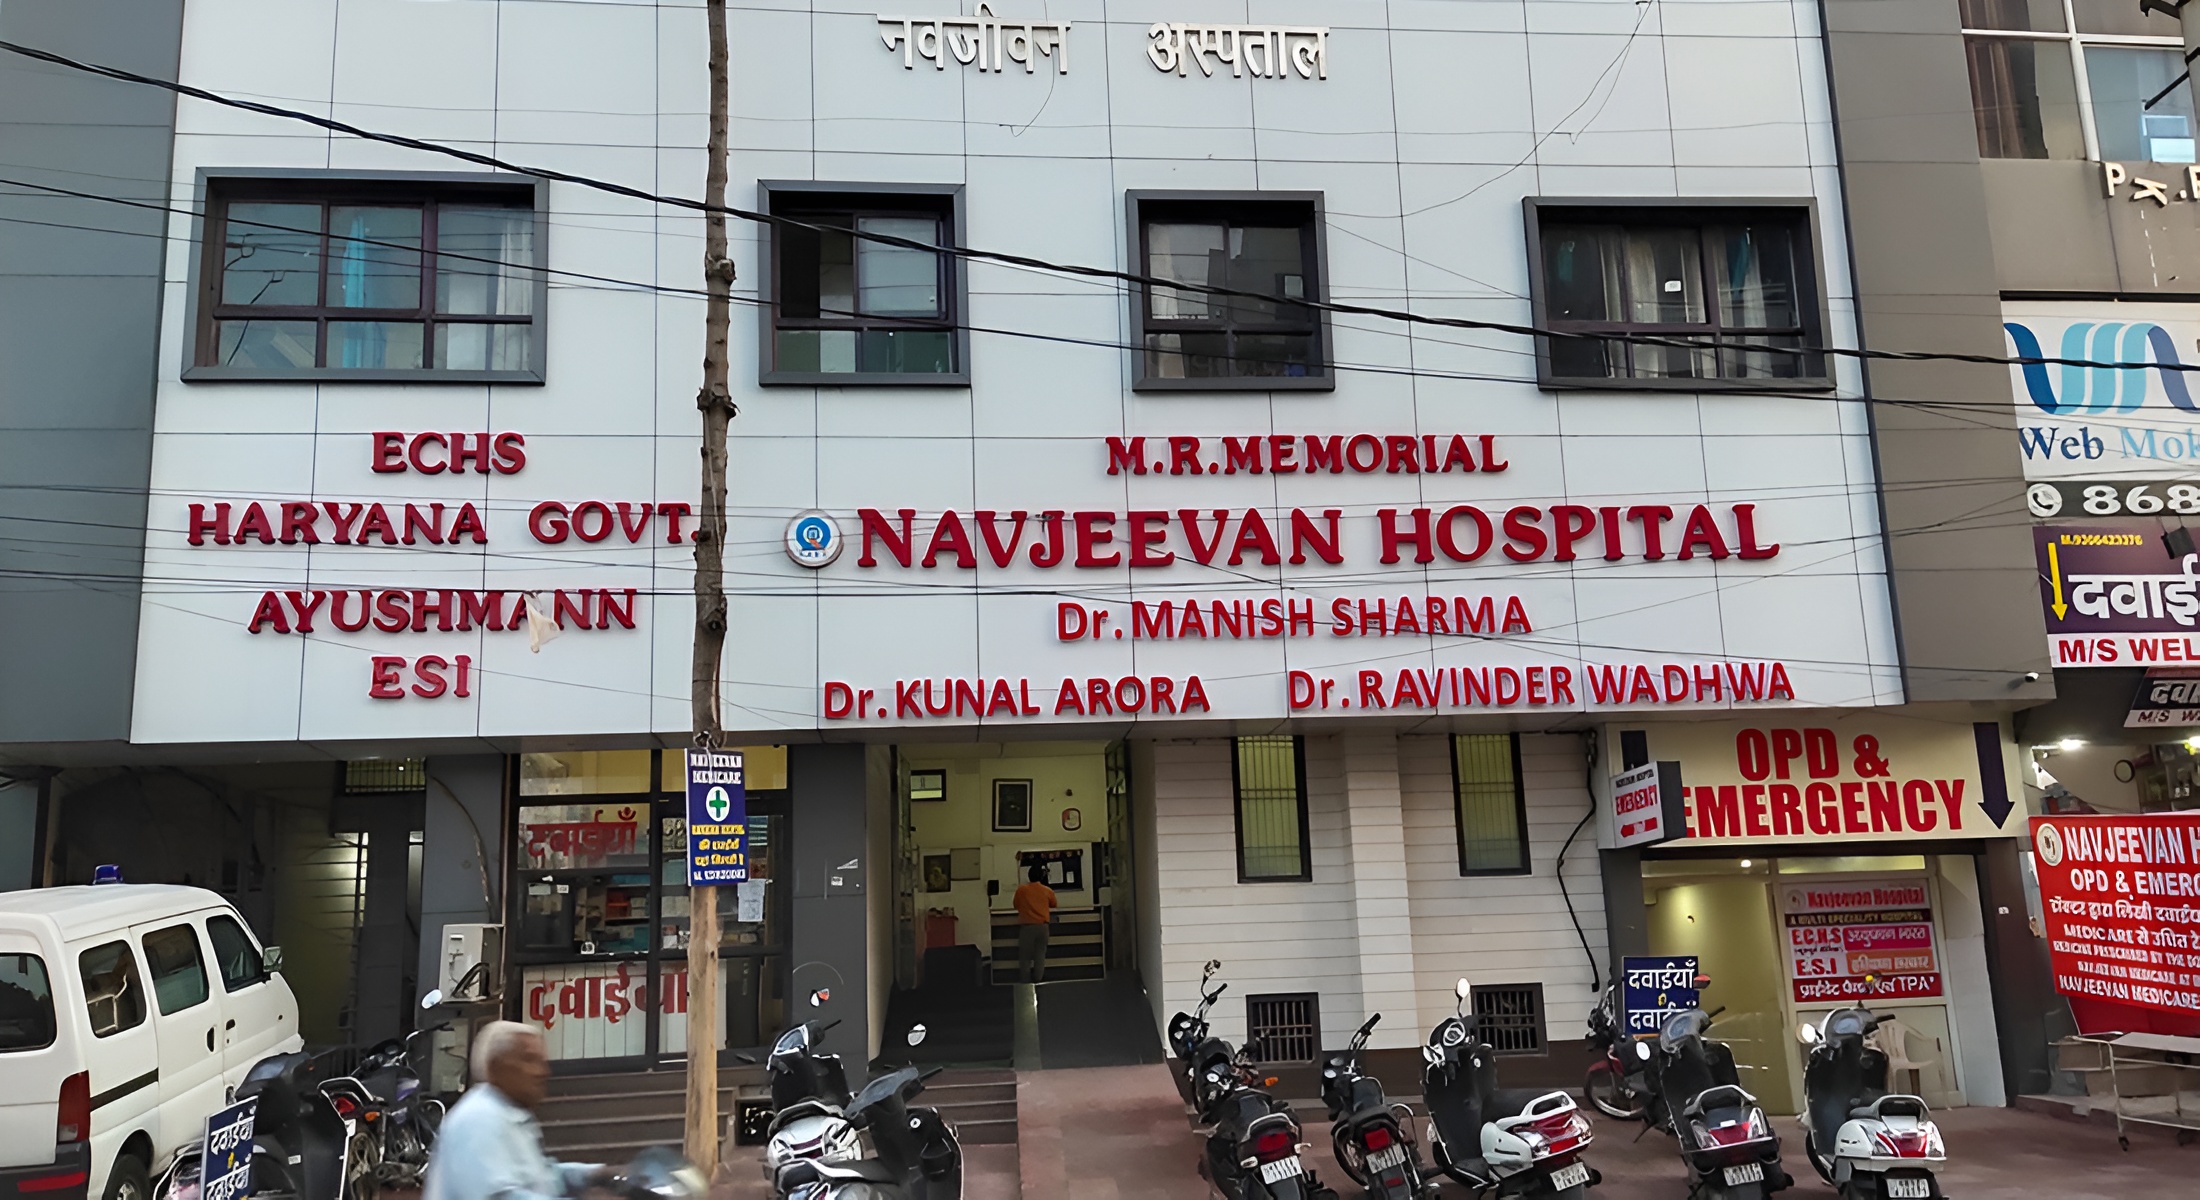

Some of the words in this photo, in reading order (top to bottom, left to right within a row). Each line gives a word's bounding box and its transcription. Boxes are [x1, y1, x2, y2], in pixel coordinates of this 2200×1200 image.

[876, 3, 1071, 74] नवजीवन
[1148, 22, 1330, 80] अस्पताल
[371, 431, 527, 475] ECHS
[1106, 433, 1509, 475] M.R.MEMORIAL
[2018, 426, 2105, 461] Web
[187, 501, 489, 546] HARYANA
[528, 500, 699, 545] GOVT.
[857, 507, 1343, 569] NAVJEEVAN
[1376, 503, 1780, 565] HOSPITAL
[1331, 595, 1533, 637] SHARMA
[2058, 637, 2119, 663] M/S
[2128, 638, 2200, 662] WEL
[368, 654, 472, 699] ESI
[1054, 675, 1212, 716] ARORA
[1587, 661, 1796, 702] WADHWA
[1736, 728, 1840, 782] OPD
[1853, 734, 1891, 778] &
[2064, 826, 2186, 865] NAVJEEVAN
[2070, 868, 2109, 892] OPD
[2115, 869, 2131, 894] &
